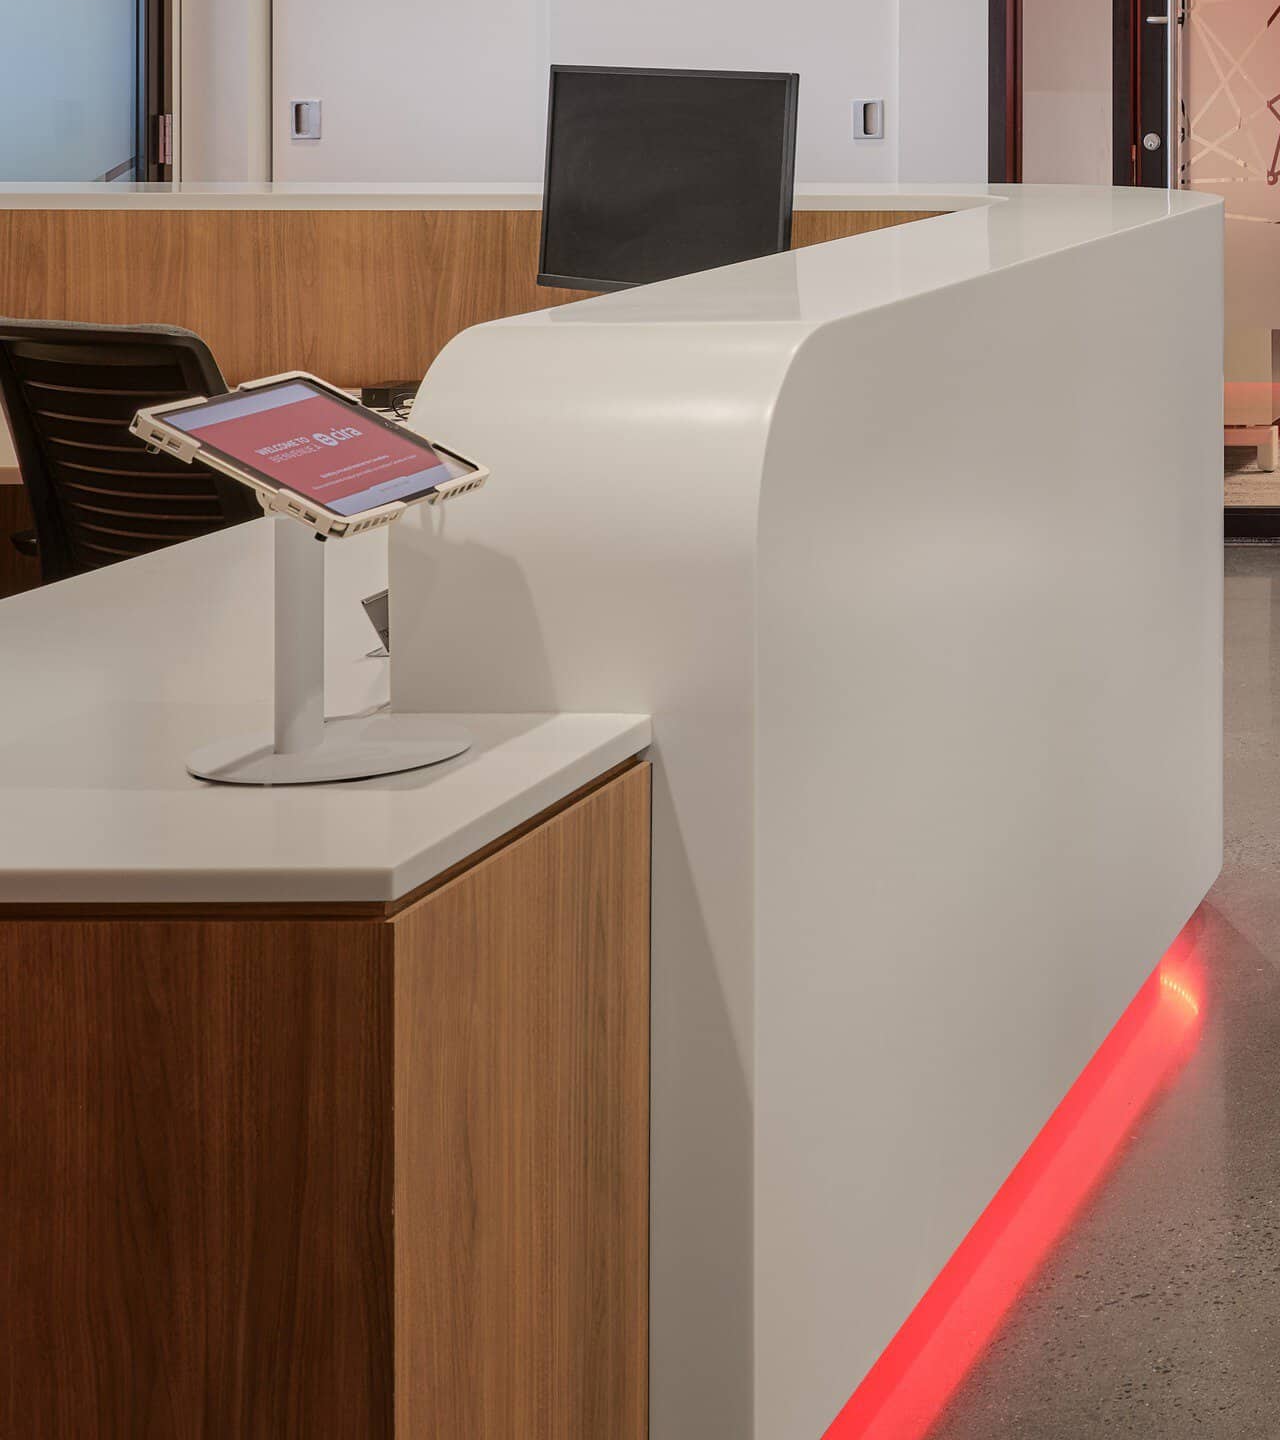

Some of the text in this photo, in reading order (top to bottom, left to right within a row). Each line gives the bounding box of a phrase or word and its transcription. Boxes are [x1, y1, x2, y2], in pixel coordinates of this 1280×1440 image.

[330, 426, 363, 441] cira
[255, 436, 311, 456] WELCOME TO
